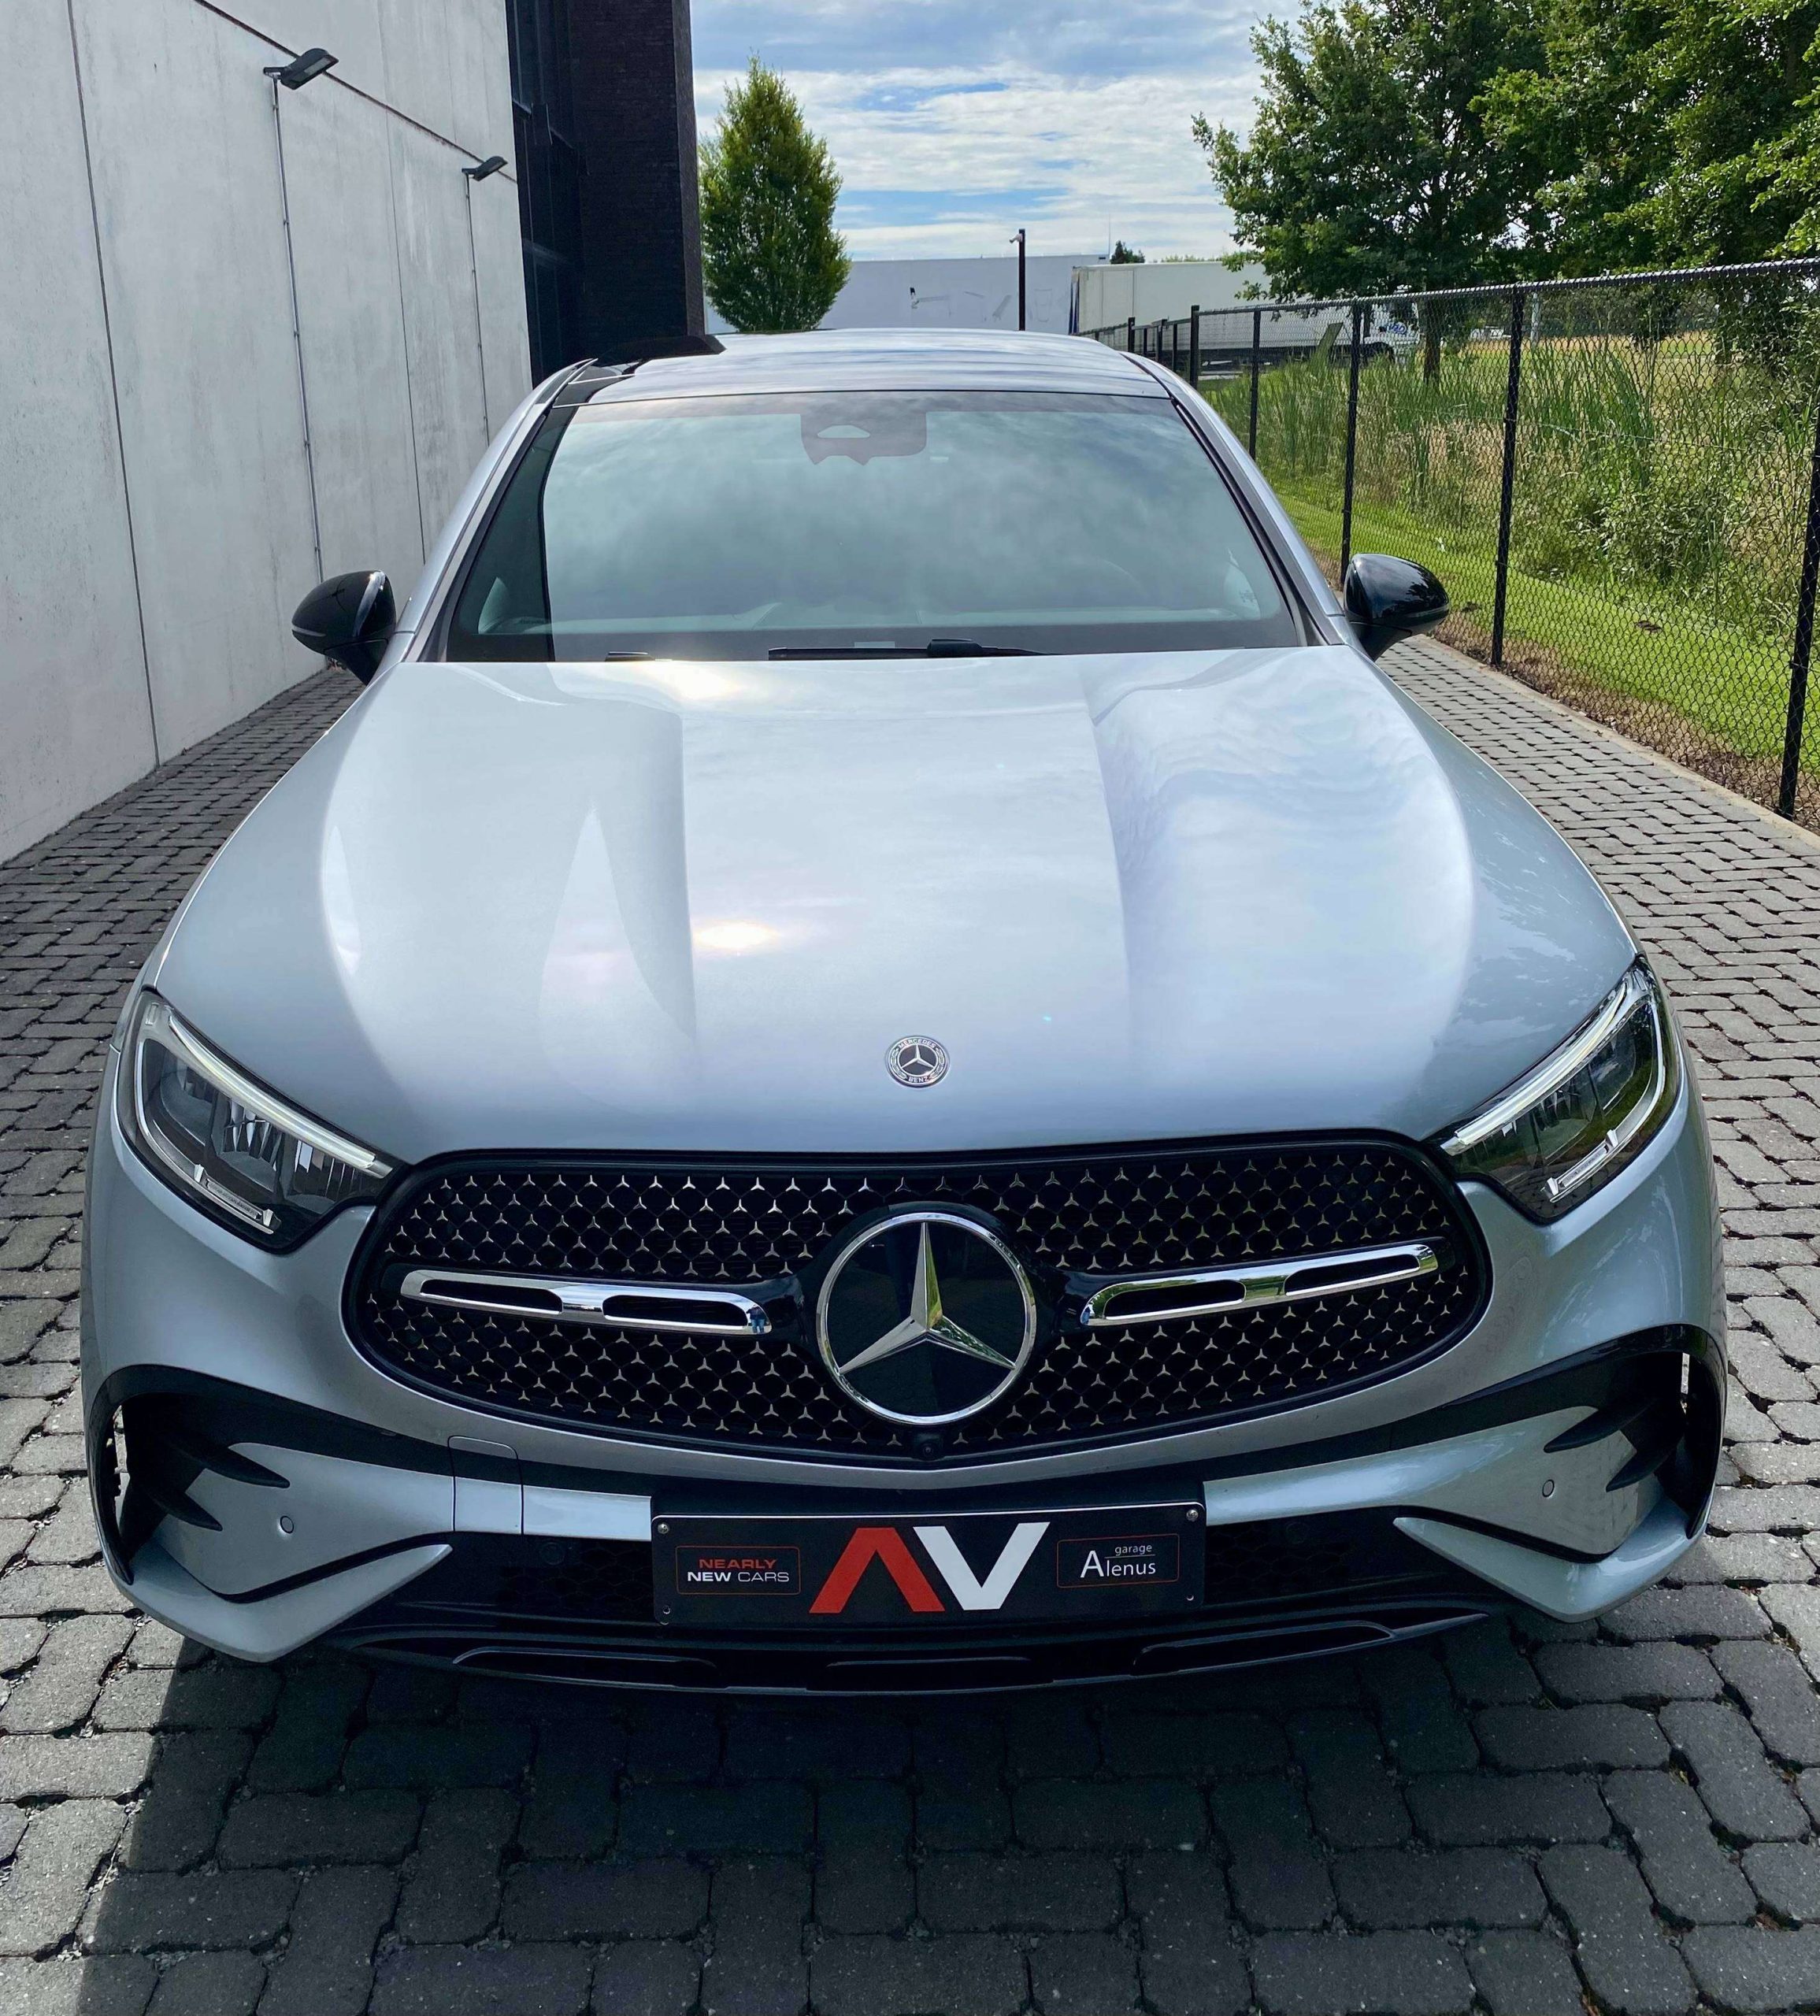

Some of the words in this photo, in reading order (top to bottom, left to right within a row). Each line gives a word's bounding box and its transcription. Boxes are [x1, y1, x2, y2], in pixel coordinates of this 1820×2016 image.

[898, 1039, 936, 1049] MERCEDES
[1114, 1544, 1153, 1556] garage
[699, 1558, 777, 1569] NEARLY
[1080, 1550, 1156, 1578] Alenus
[687, 1572, 732, 1582] NEW
[738, 1572, 790, 1582] CARS
